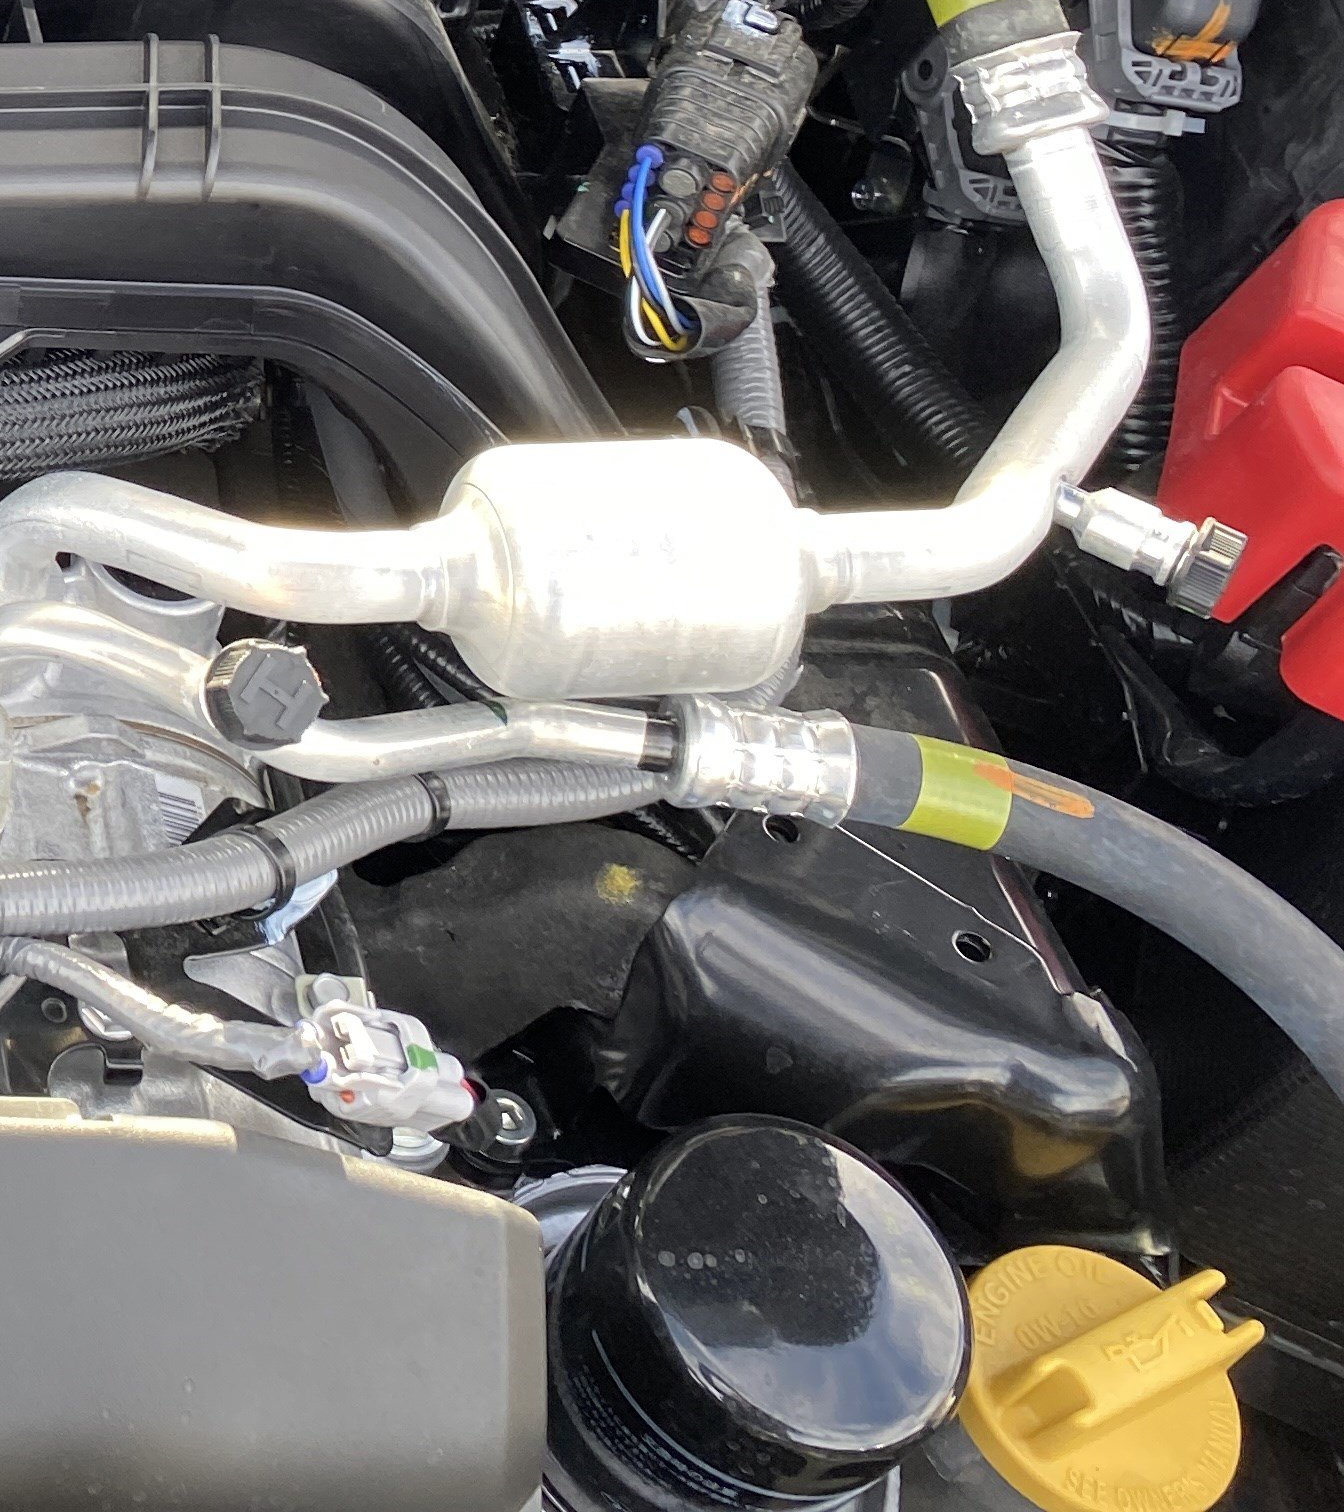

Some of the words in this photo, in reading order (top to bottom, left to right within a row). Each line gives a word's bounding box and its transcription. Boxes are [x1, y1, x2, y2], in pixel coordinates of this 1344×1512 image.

[240, 652, 312, 731] H
[976, 1255, 1049, 1347] ENGINE
[1054, 1251, 1124, 1288] OIL
